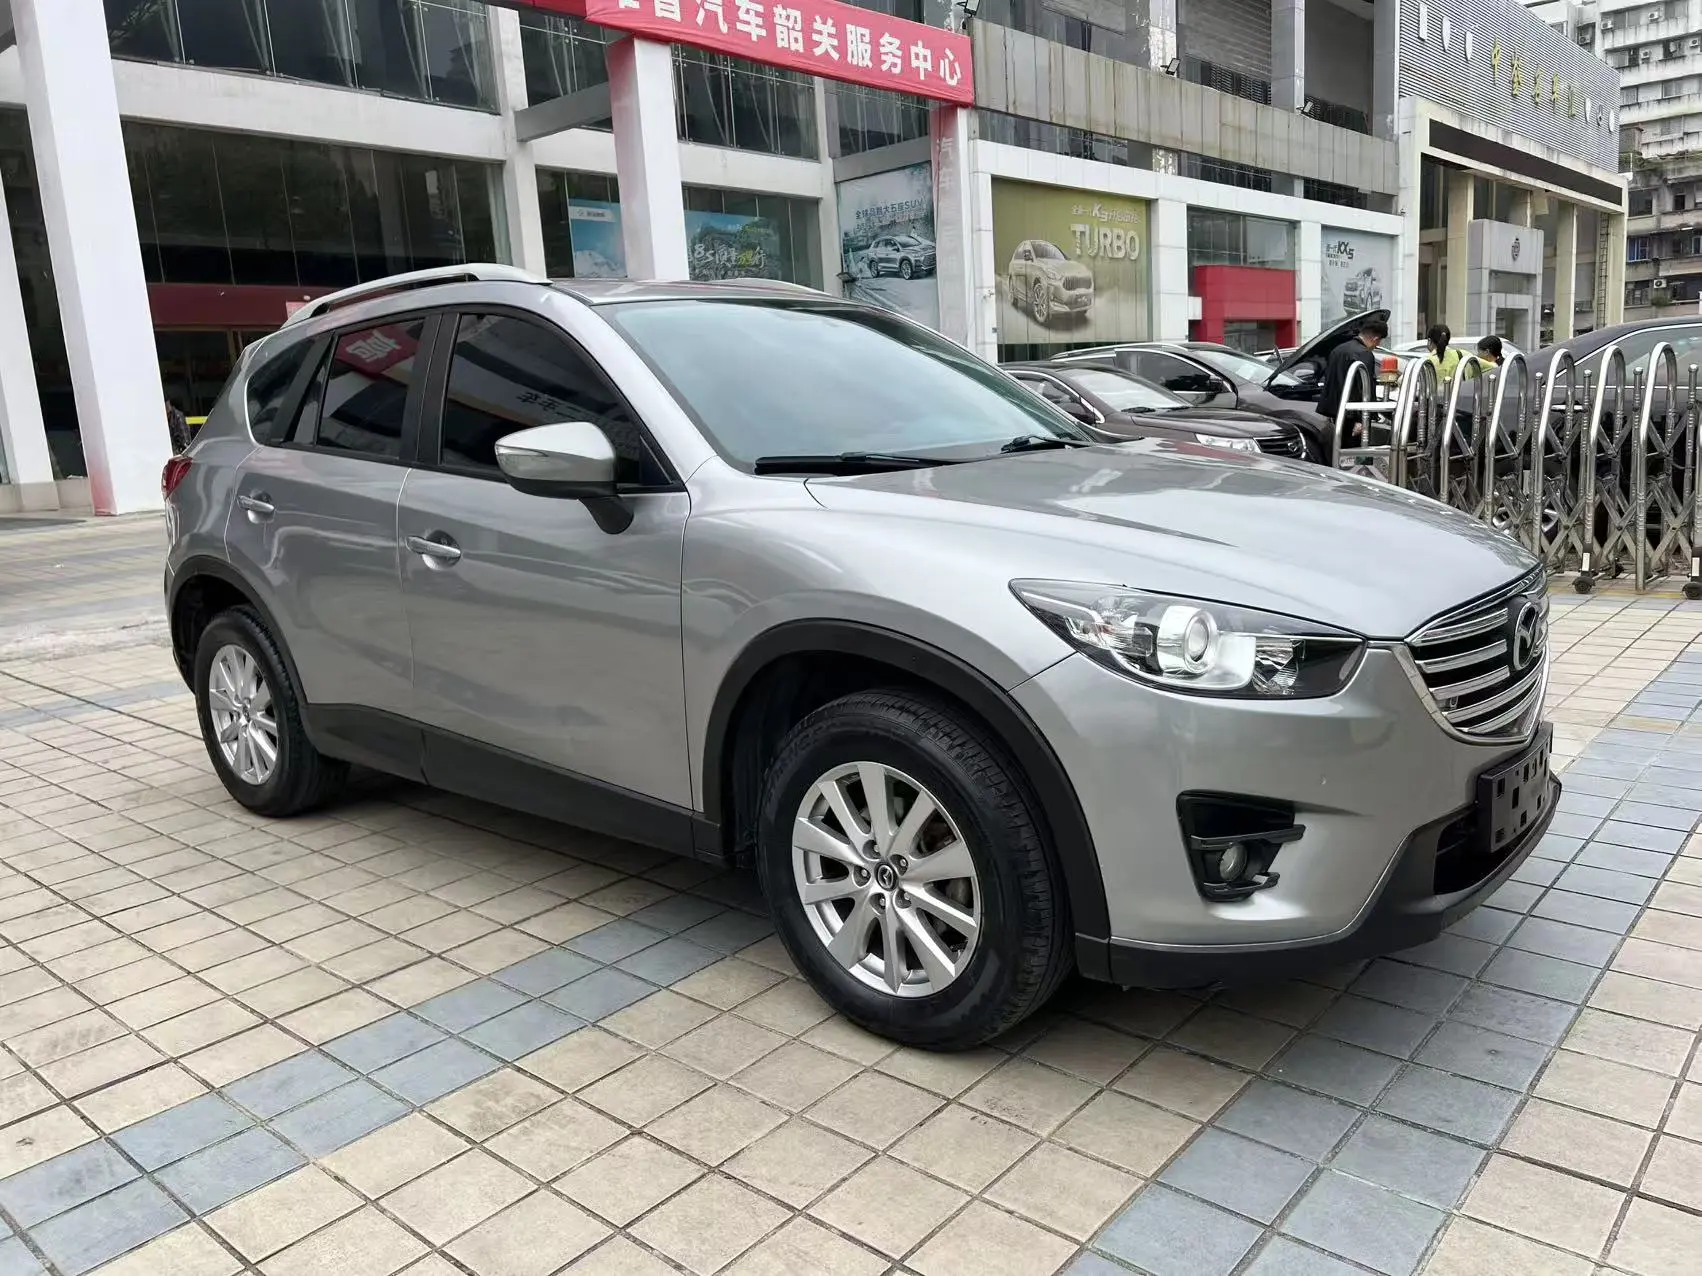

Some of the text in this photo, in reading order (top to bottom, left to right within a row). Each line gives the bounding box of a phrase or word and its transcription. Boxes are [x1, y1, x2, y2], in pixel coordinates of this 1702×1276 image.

[618, 0, 962, 86] 汽车韶关服务中心
[1070, 223, 1140, 260] TURBO
